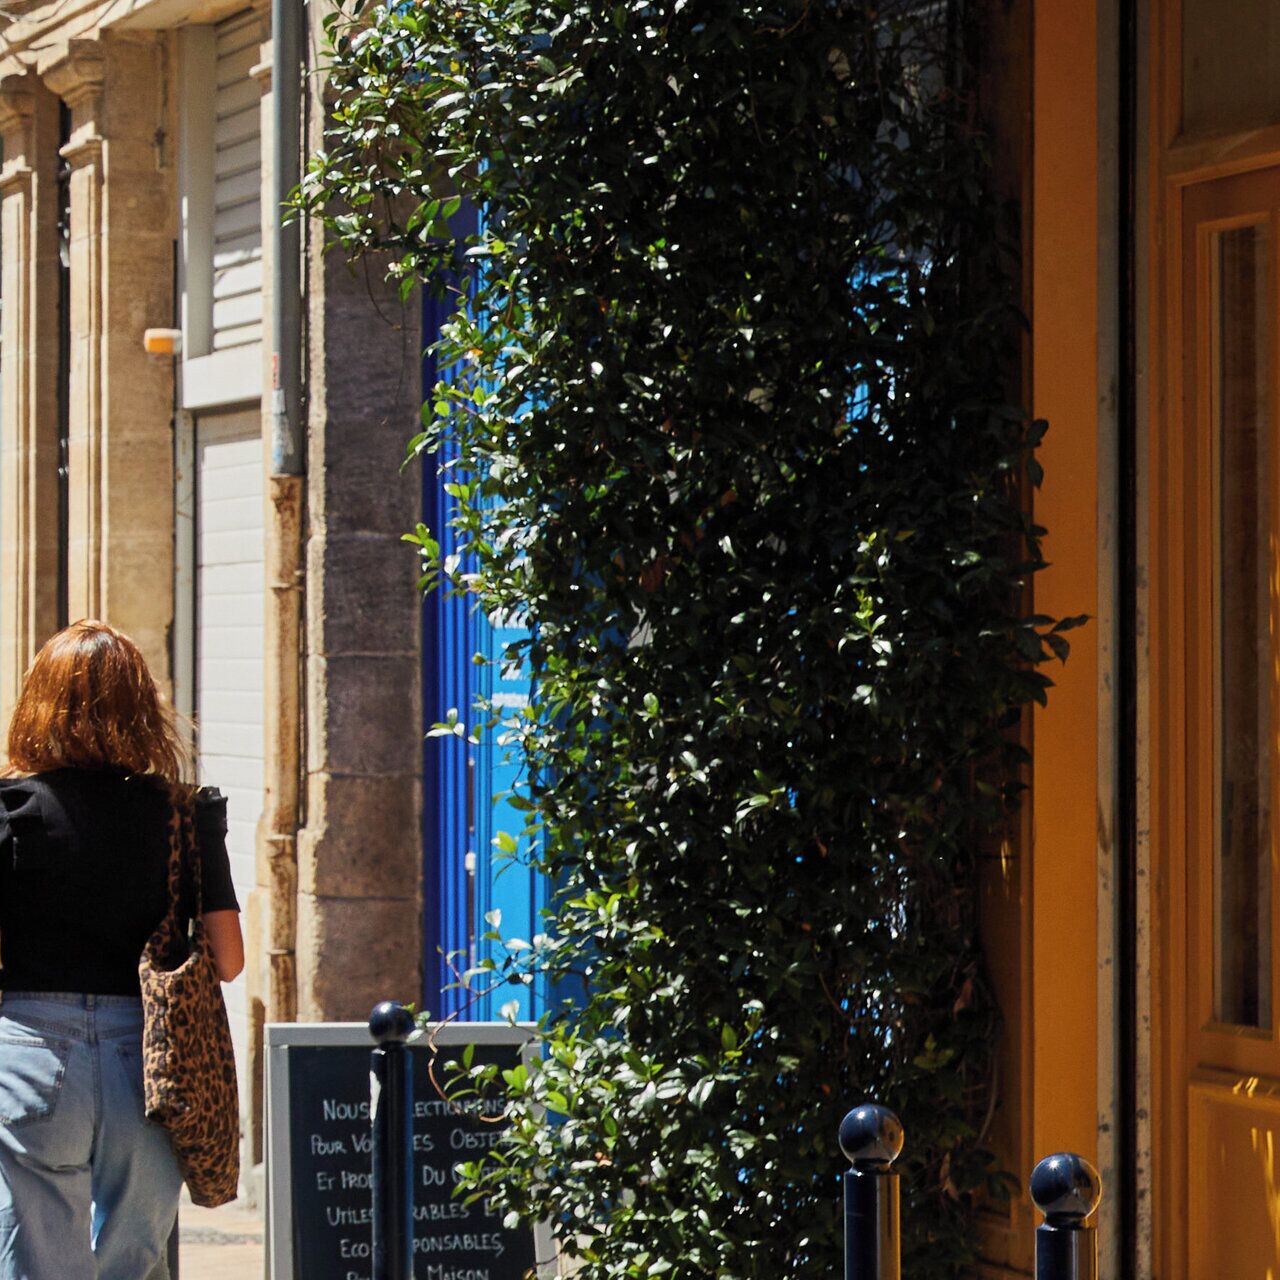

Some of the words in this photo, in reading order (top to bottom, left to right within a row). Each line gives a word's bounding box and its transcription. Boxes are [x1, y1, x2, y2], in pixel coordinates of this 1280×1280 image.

[323, 1099, 370, 1121] NOUS
[412, 1133, 435, 1152] ES
[423, 1165, 445, 1187] DU
